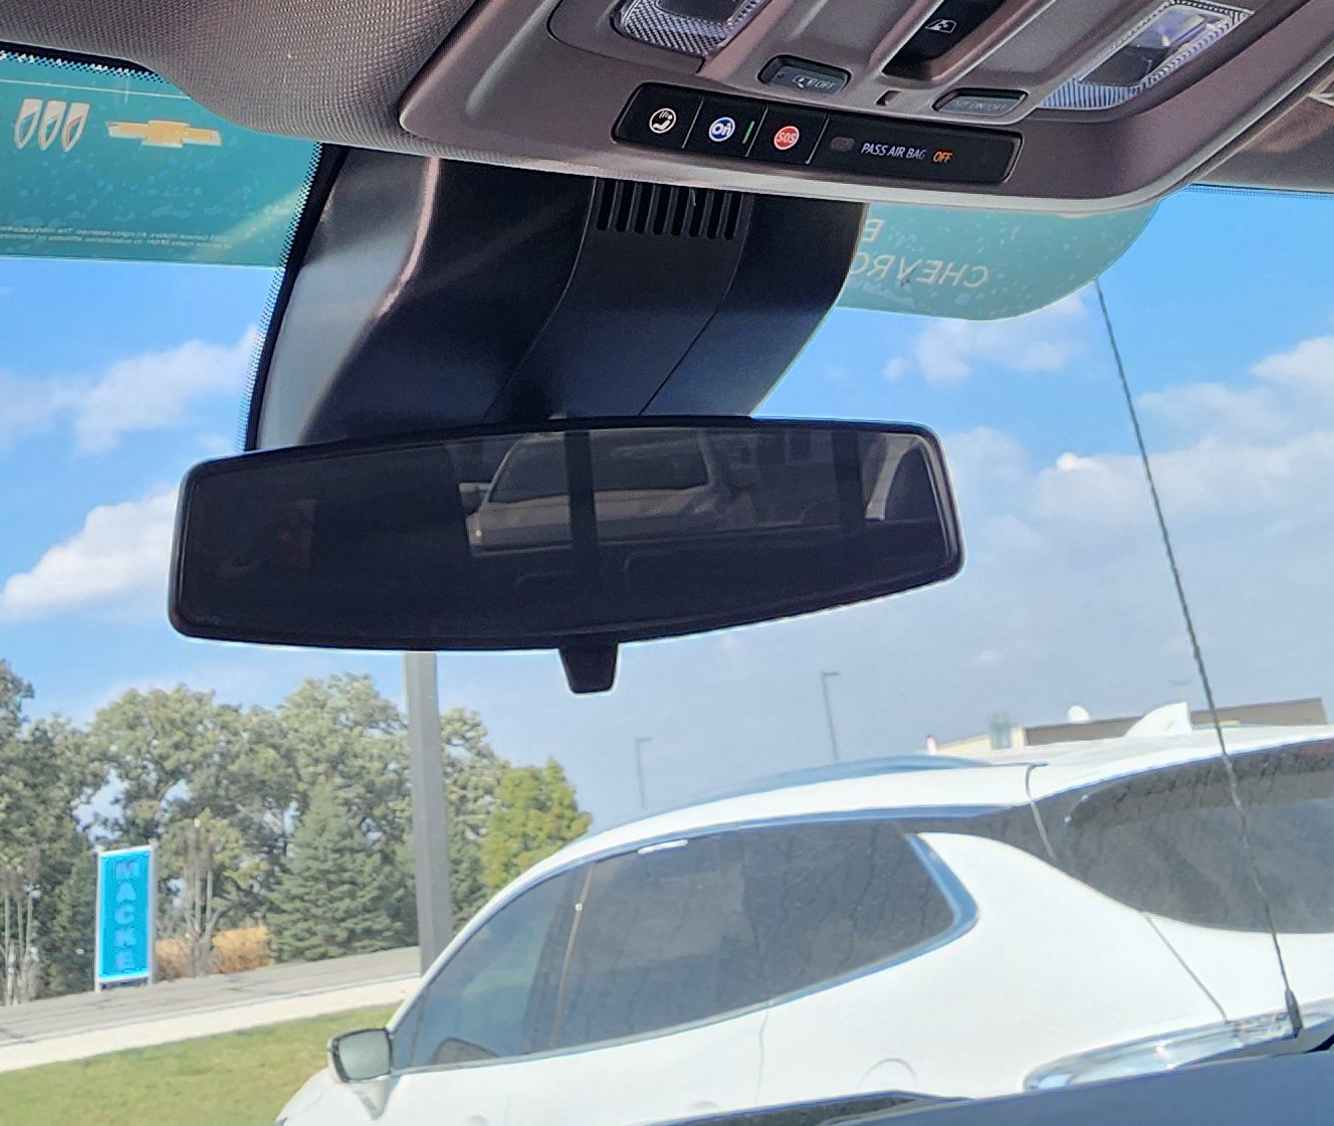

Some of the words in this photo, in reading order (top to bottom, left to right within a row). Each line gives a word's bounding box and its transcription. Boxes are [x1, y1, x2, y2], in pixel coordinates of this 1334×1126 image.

[776, 131, 798, 144] SOS
[860, 142, 888, 157] PASS
[887, 145, 906, 158] AIR
[905, 148, 928, 161] BAG
[931, 150, 954, 163] OFF
